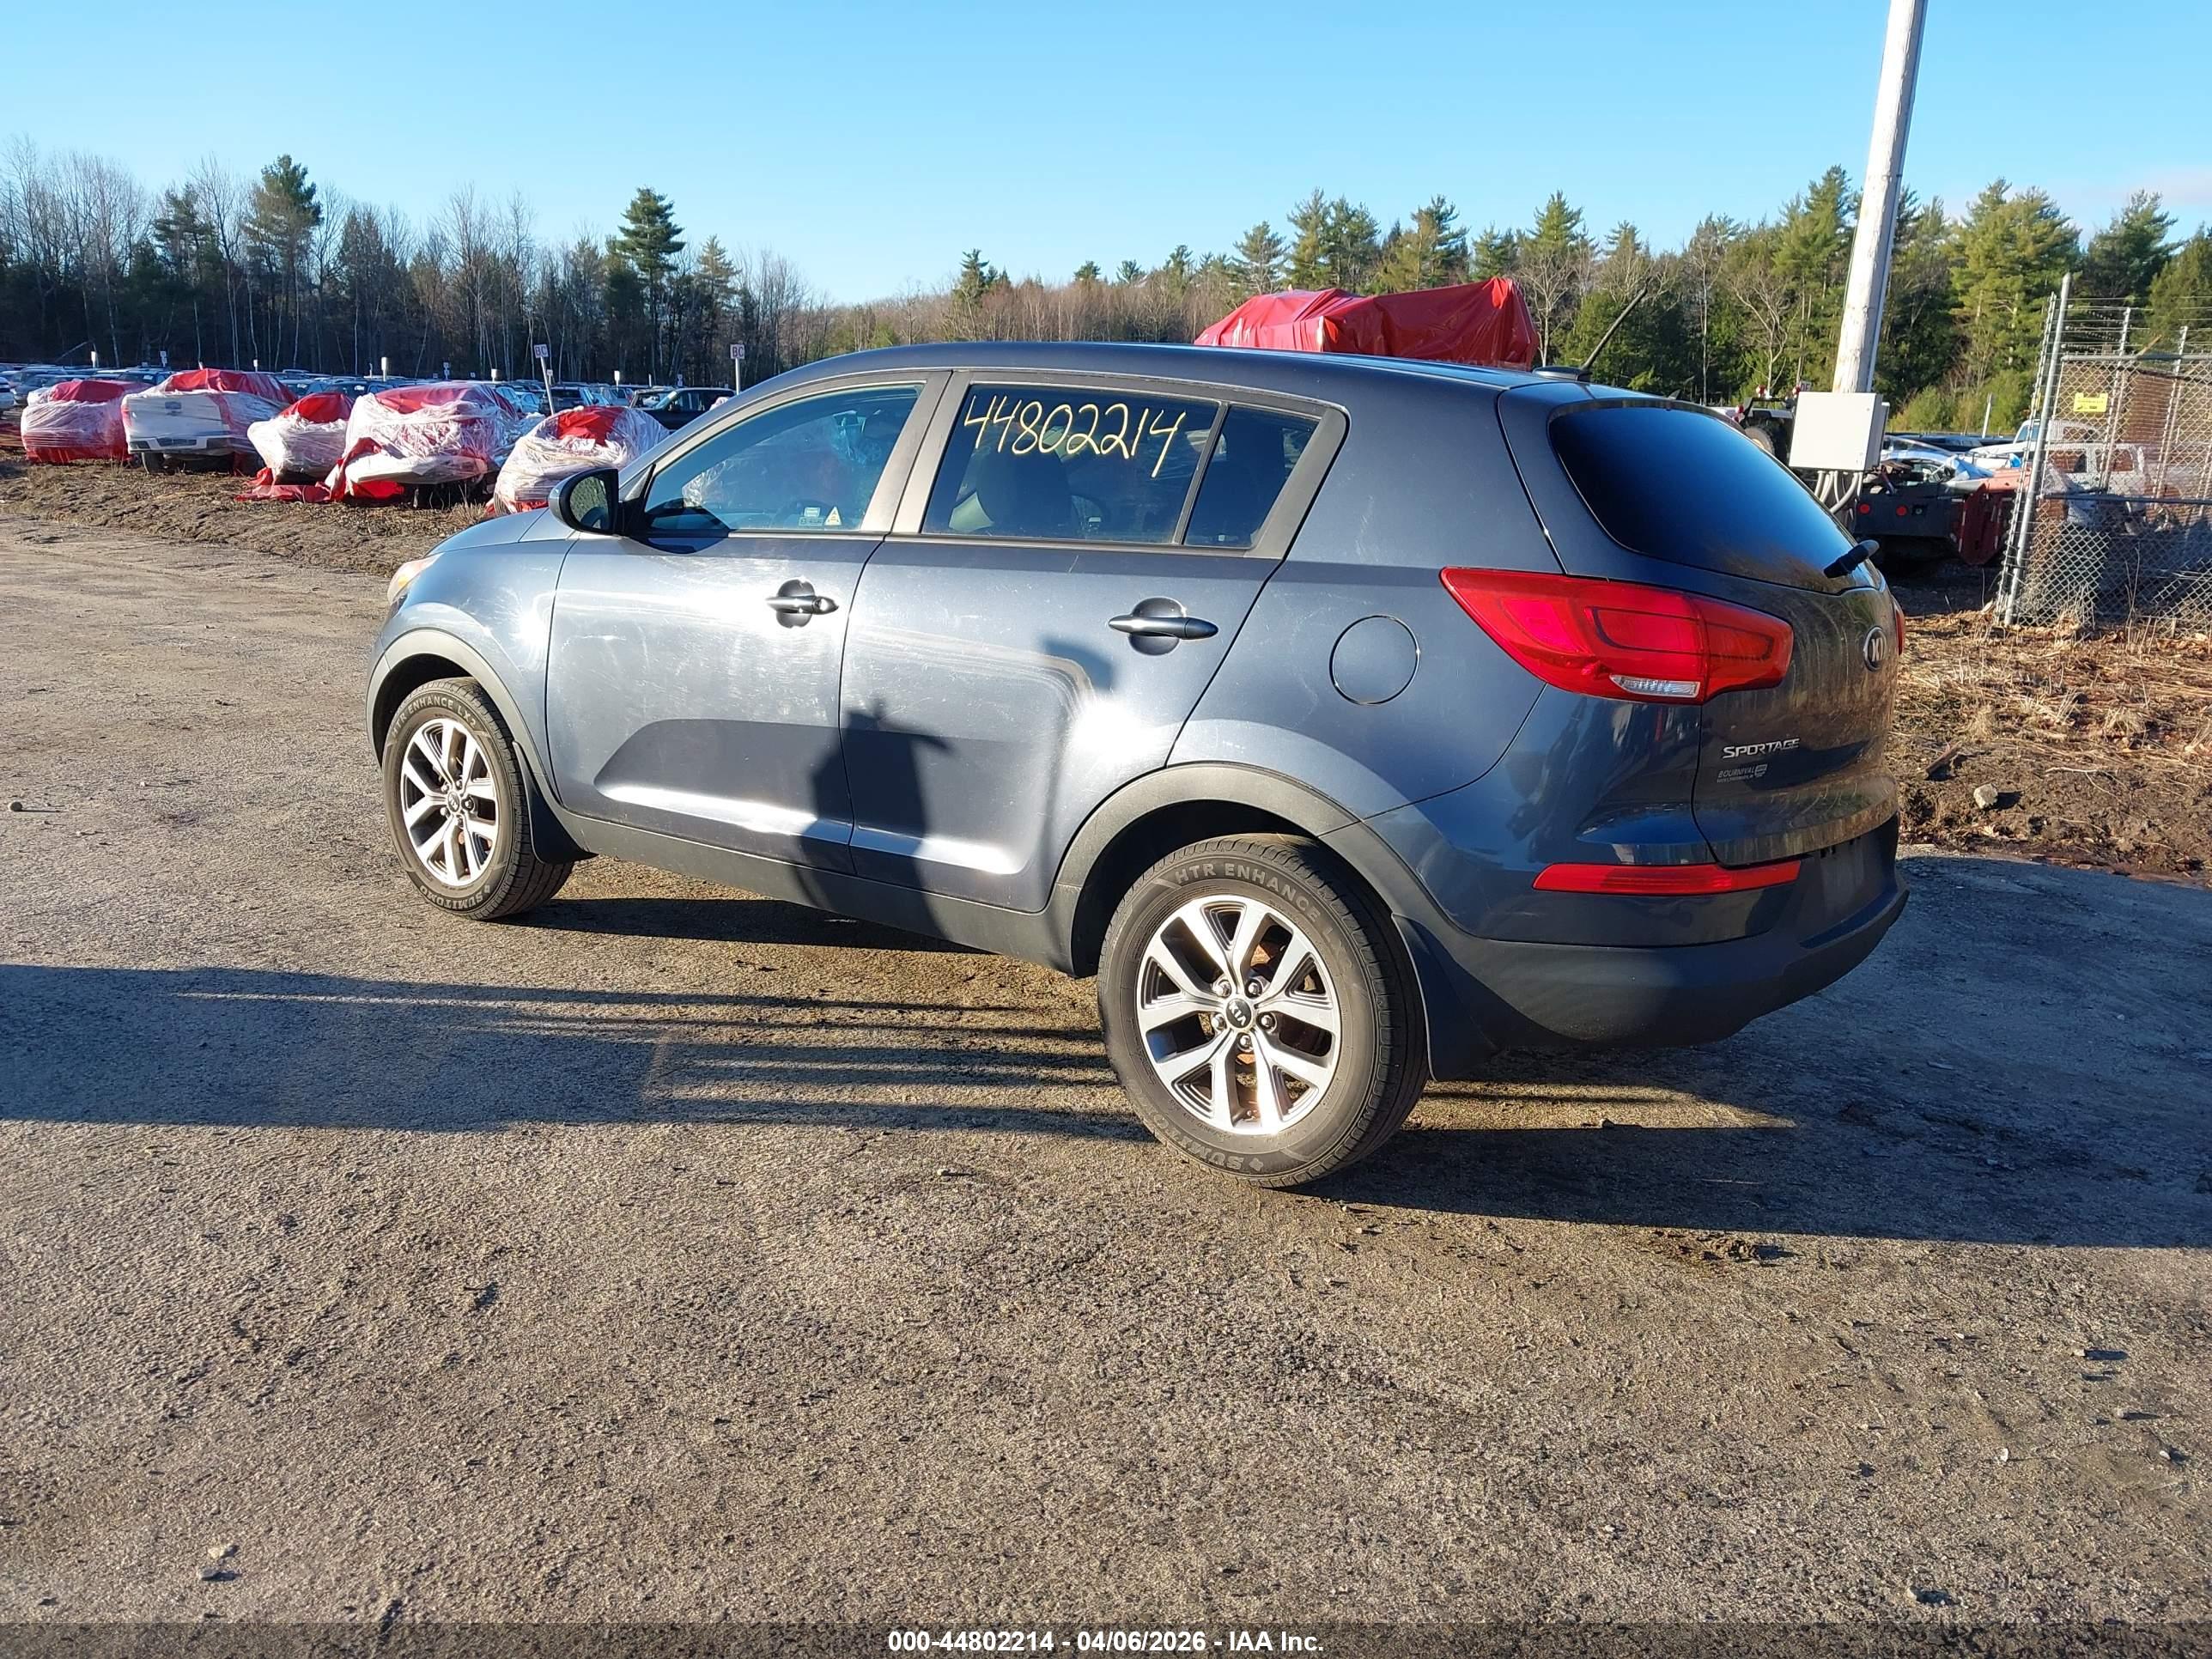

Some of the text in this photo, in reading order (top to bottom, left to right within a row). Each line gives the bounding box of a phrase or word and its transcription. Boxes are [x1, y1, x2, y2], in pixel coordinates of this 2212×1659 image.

[535, 346, 547, 356] BC
[732, 346, 744, 357] BC
[963, 394, 1187, 478] 44802214
[391, 704, 408, 738] HTR
[407, 695, 454, 714] ENHANCE
[1722, 738, 1801, 759] SPORTAGE
[419, 884, 483, 909] SUMITOMO
[1175, 863, 1217, 885] HTR
[1223, 862, 1322, 923] ENHANCE
[1228, 1000, 1247, 1026] KIA
